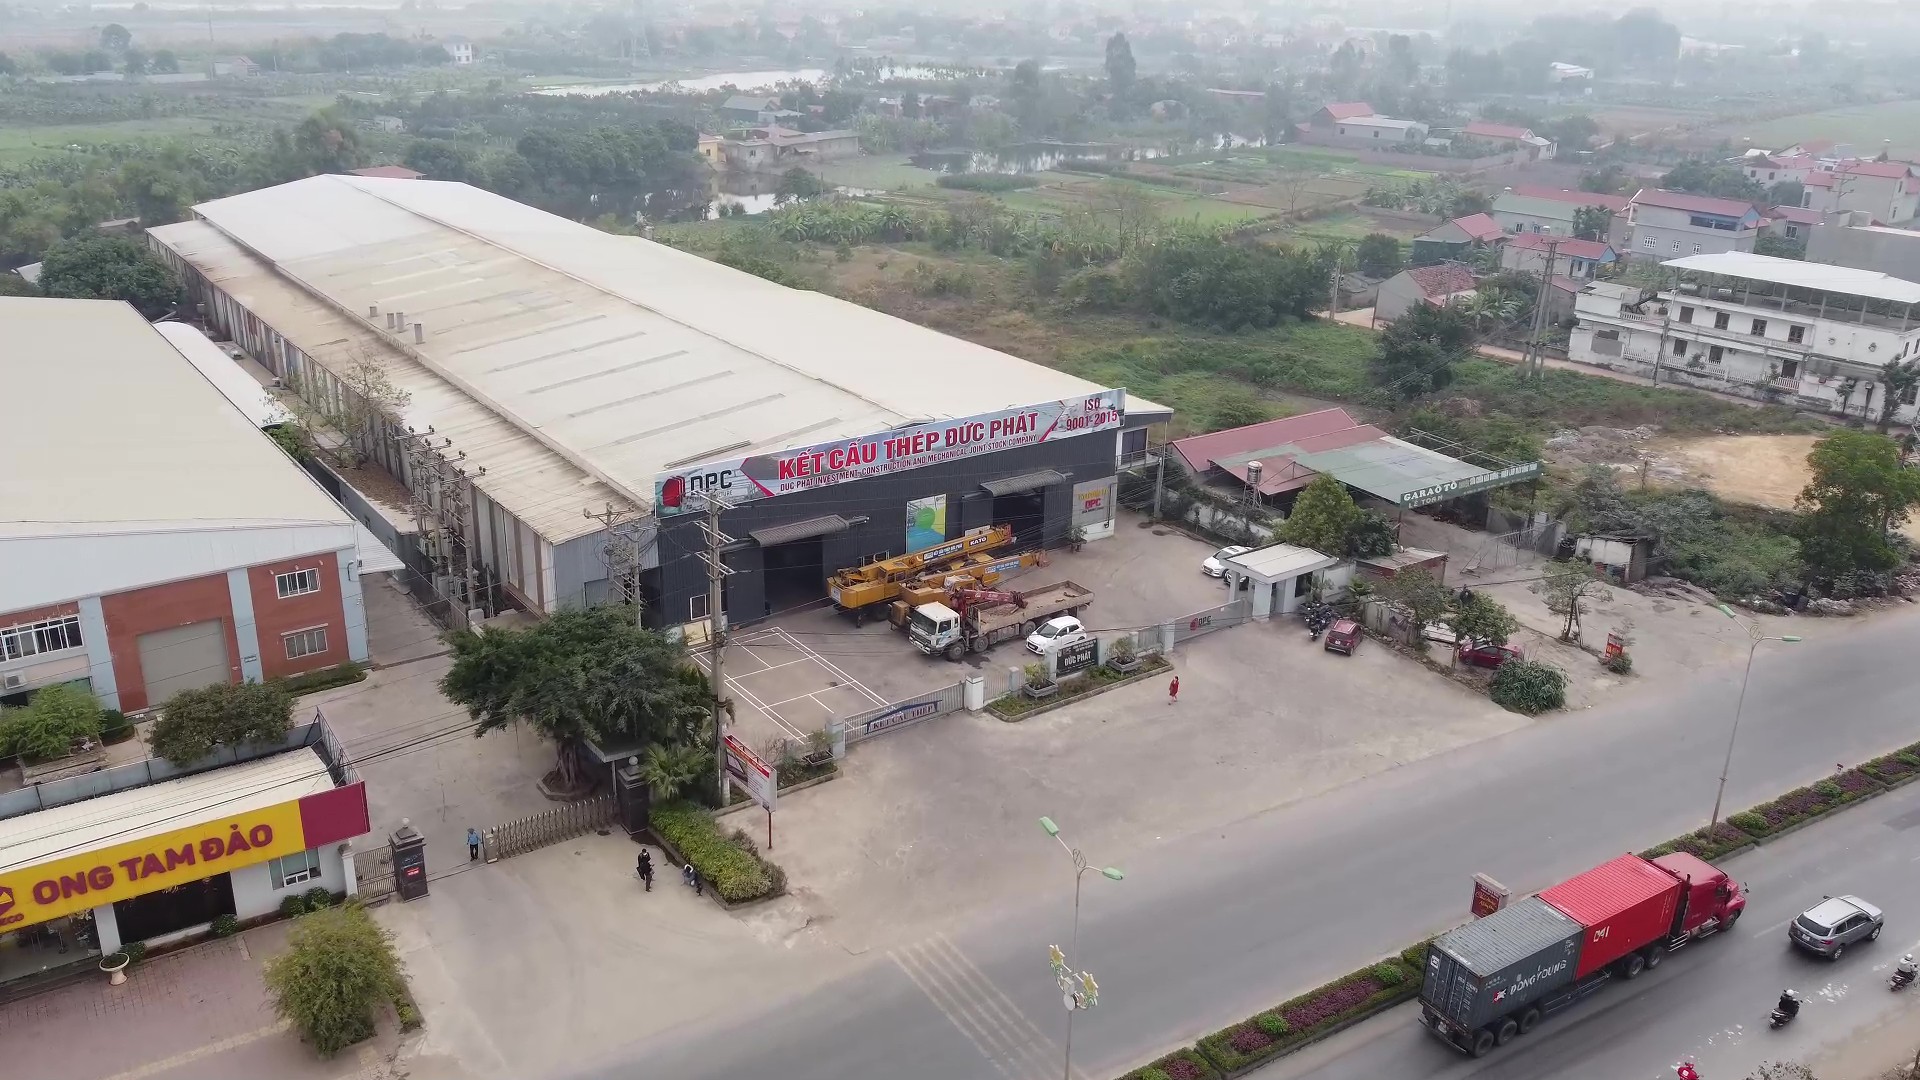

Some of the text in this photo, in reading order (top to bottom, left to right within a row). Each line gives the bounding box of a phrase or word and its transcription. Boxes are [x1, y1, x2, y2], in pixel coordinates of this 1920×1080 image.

[1084, 397, 1101, 411] ISO
[779, 410, 1039, 481] KẾT CẤU THÉP ĐỨC PHÁT
[780, 481, 795, 492] DUC
[796, 477, 815, 489] PHAT
[862, 459, 911, 475] CONSTRUCTION
[913, 456, 926, 466] AND
[927, 449, 968, 463] MECHANICAL
[969, 444, 987, 455] JOINT
[988, 440, 1007, 451] STOCK
[1008, 434, 1037, 446] COMPANY
[969, 536, 987, 546] KATO
[32, 823, 274, 905] ONG TAM ĐẢO
